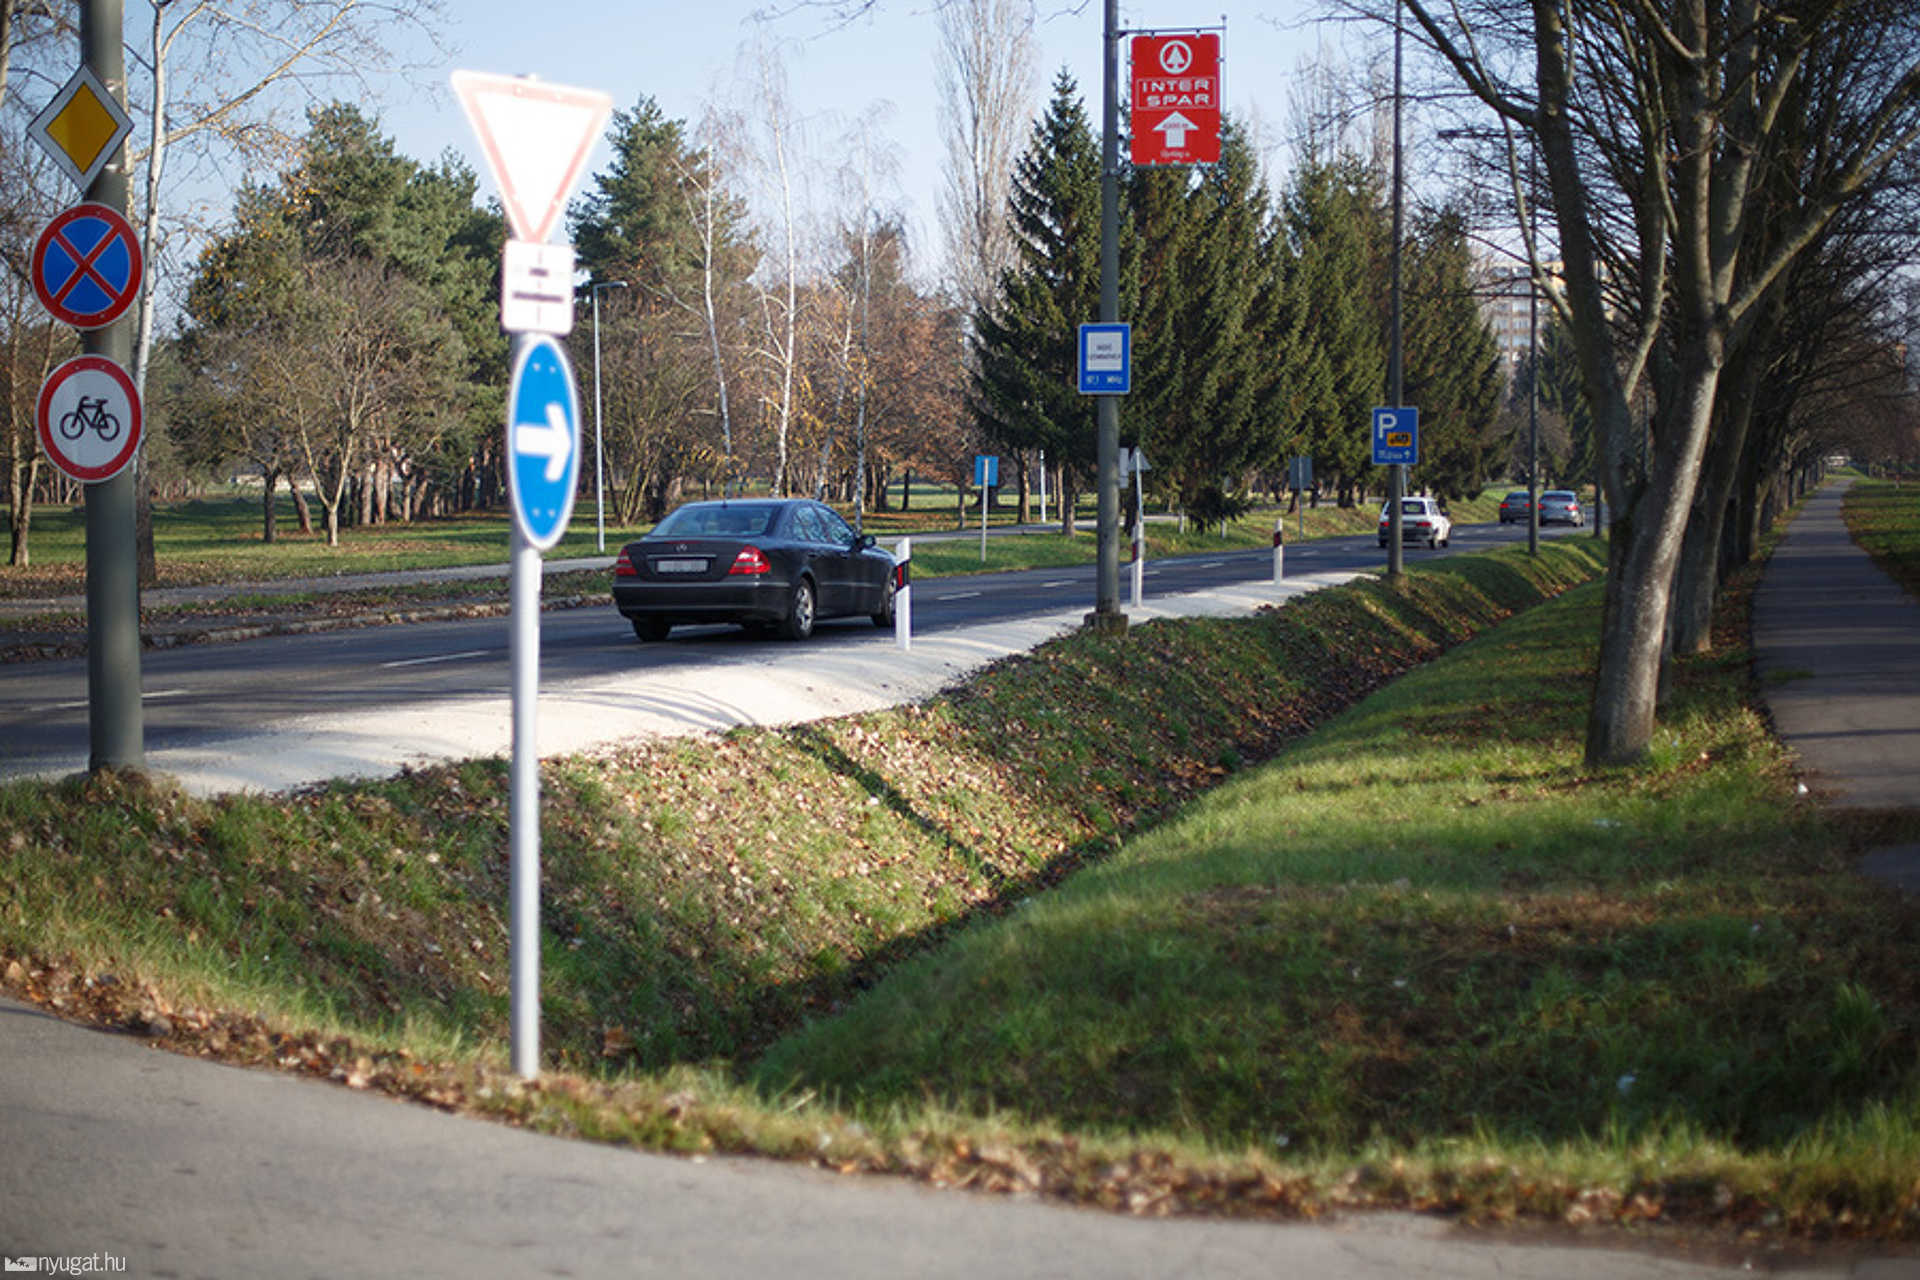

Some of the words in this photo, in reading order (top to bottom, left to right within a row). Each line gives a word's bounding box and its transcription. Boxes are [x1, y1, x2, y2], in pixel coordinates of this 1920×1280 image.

[1142, 79, 1209, 93] INTER
[1146, 93, 1209, 107] SPAR
[1378, 413, 1397, 439] P
